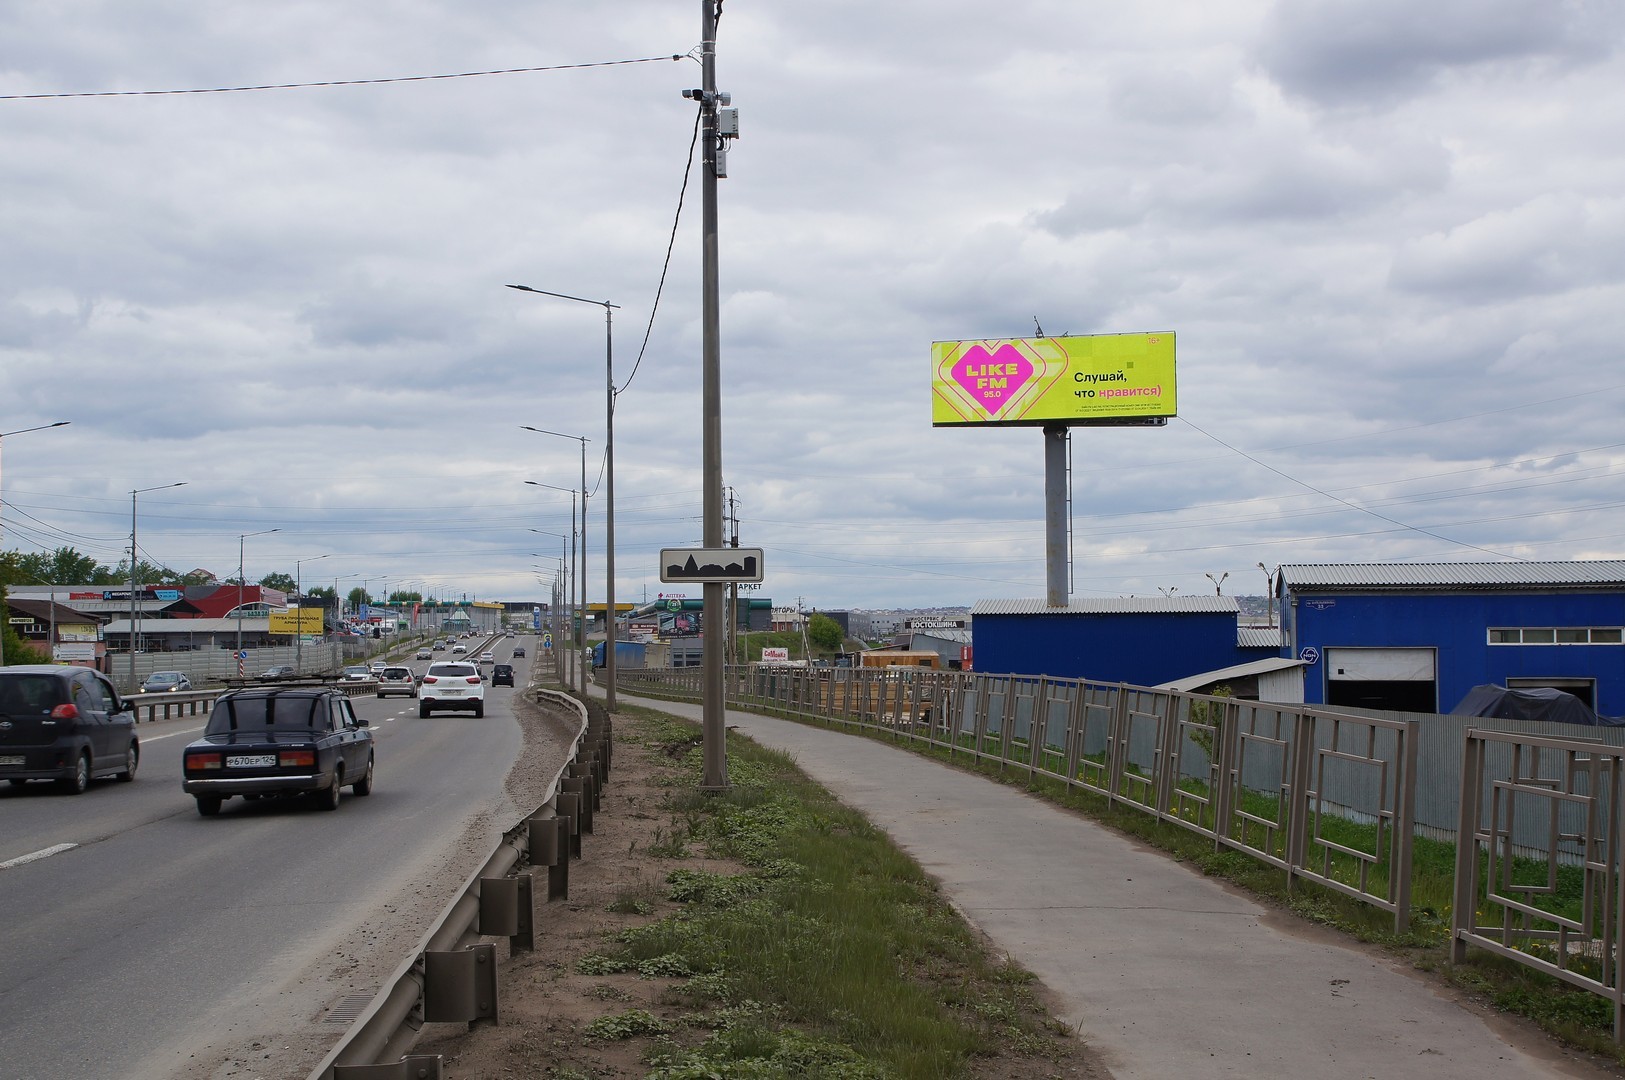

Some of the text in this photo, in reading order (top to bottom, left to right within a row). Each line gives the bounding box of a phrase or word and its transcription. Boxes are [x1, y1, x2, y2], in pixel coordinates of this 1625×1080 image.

[966, 363, 1018, 377] LIKE
[1074, 370, 1127, 384] Слушай,
[977, 377, 1008, 389] FM
[983, 390, 1001, 398] 95.0
[1074, 384, 1161, 399] что нравится)
